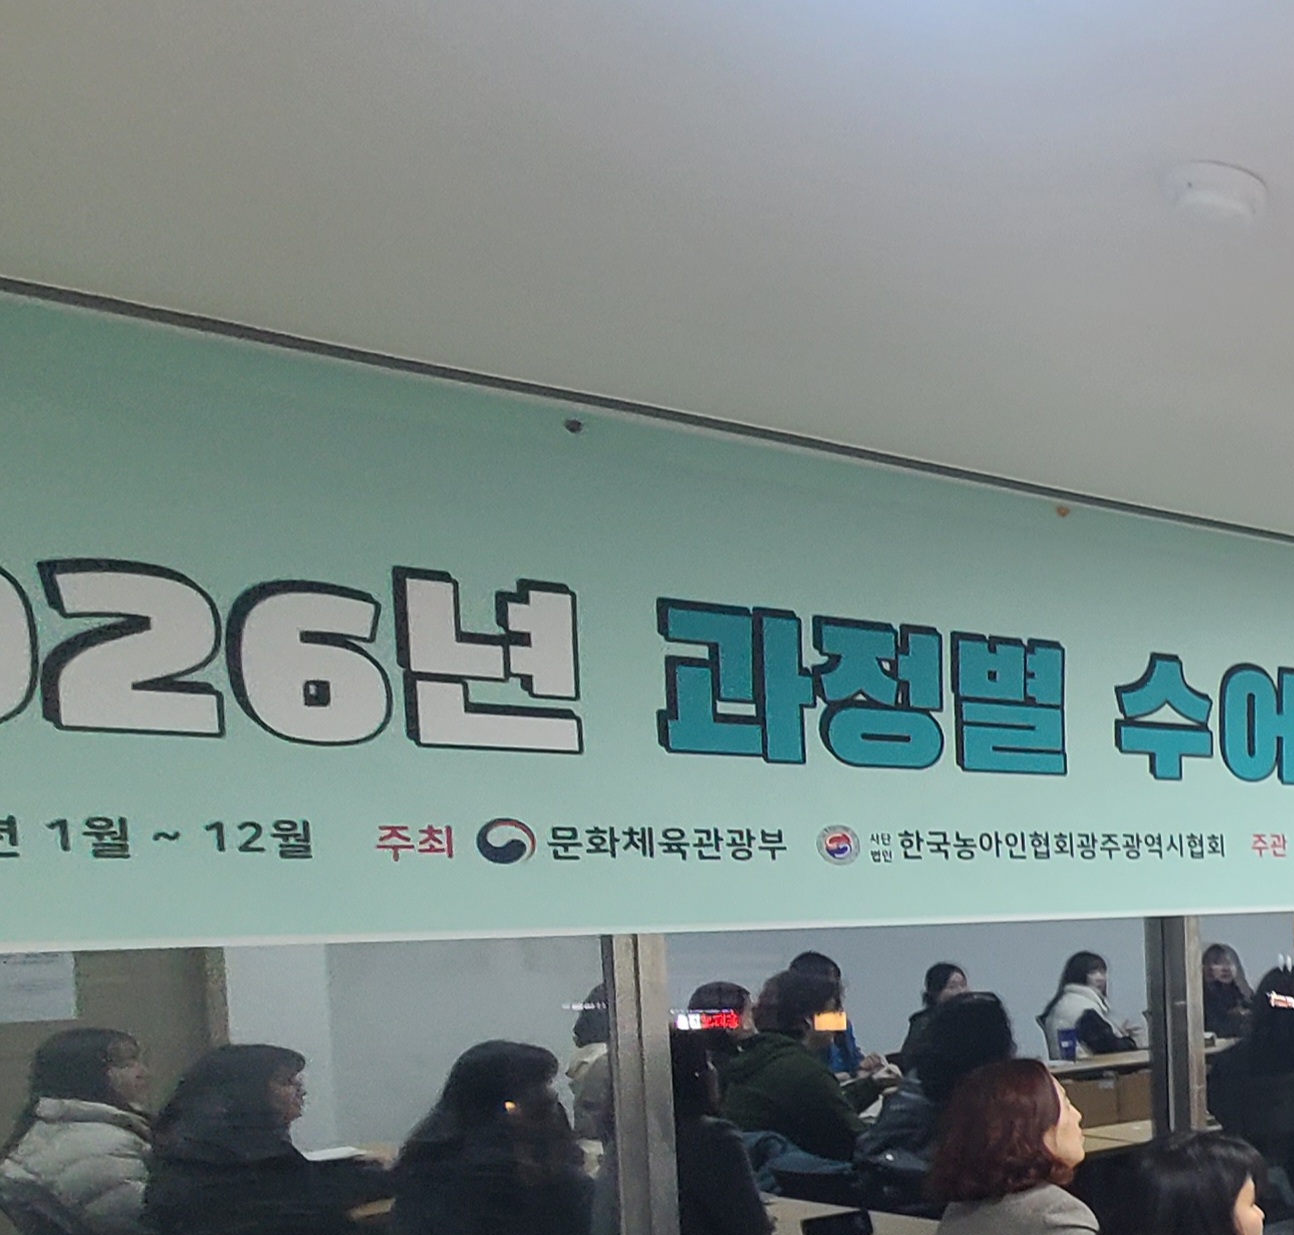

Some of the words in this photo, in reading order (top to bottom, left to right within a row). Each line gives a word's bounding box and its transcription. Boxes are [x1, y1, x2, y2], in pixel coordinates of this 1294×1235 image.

[656, 597, 1068, 776] 과정별
[49, 815, 131, 859] 1월
[205, 817, 313, 859] 12월
[375, 823, 453, 862] 주최
[547, 826, 787, 862] 문화체육관광부
[899, 830, 1226, 861] 한국농아인협회광주광역시협회
[1251, 833, 1287, 858] 주관
